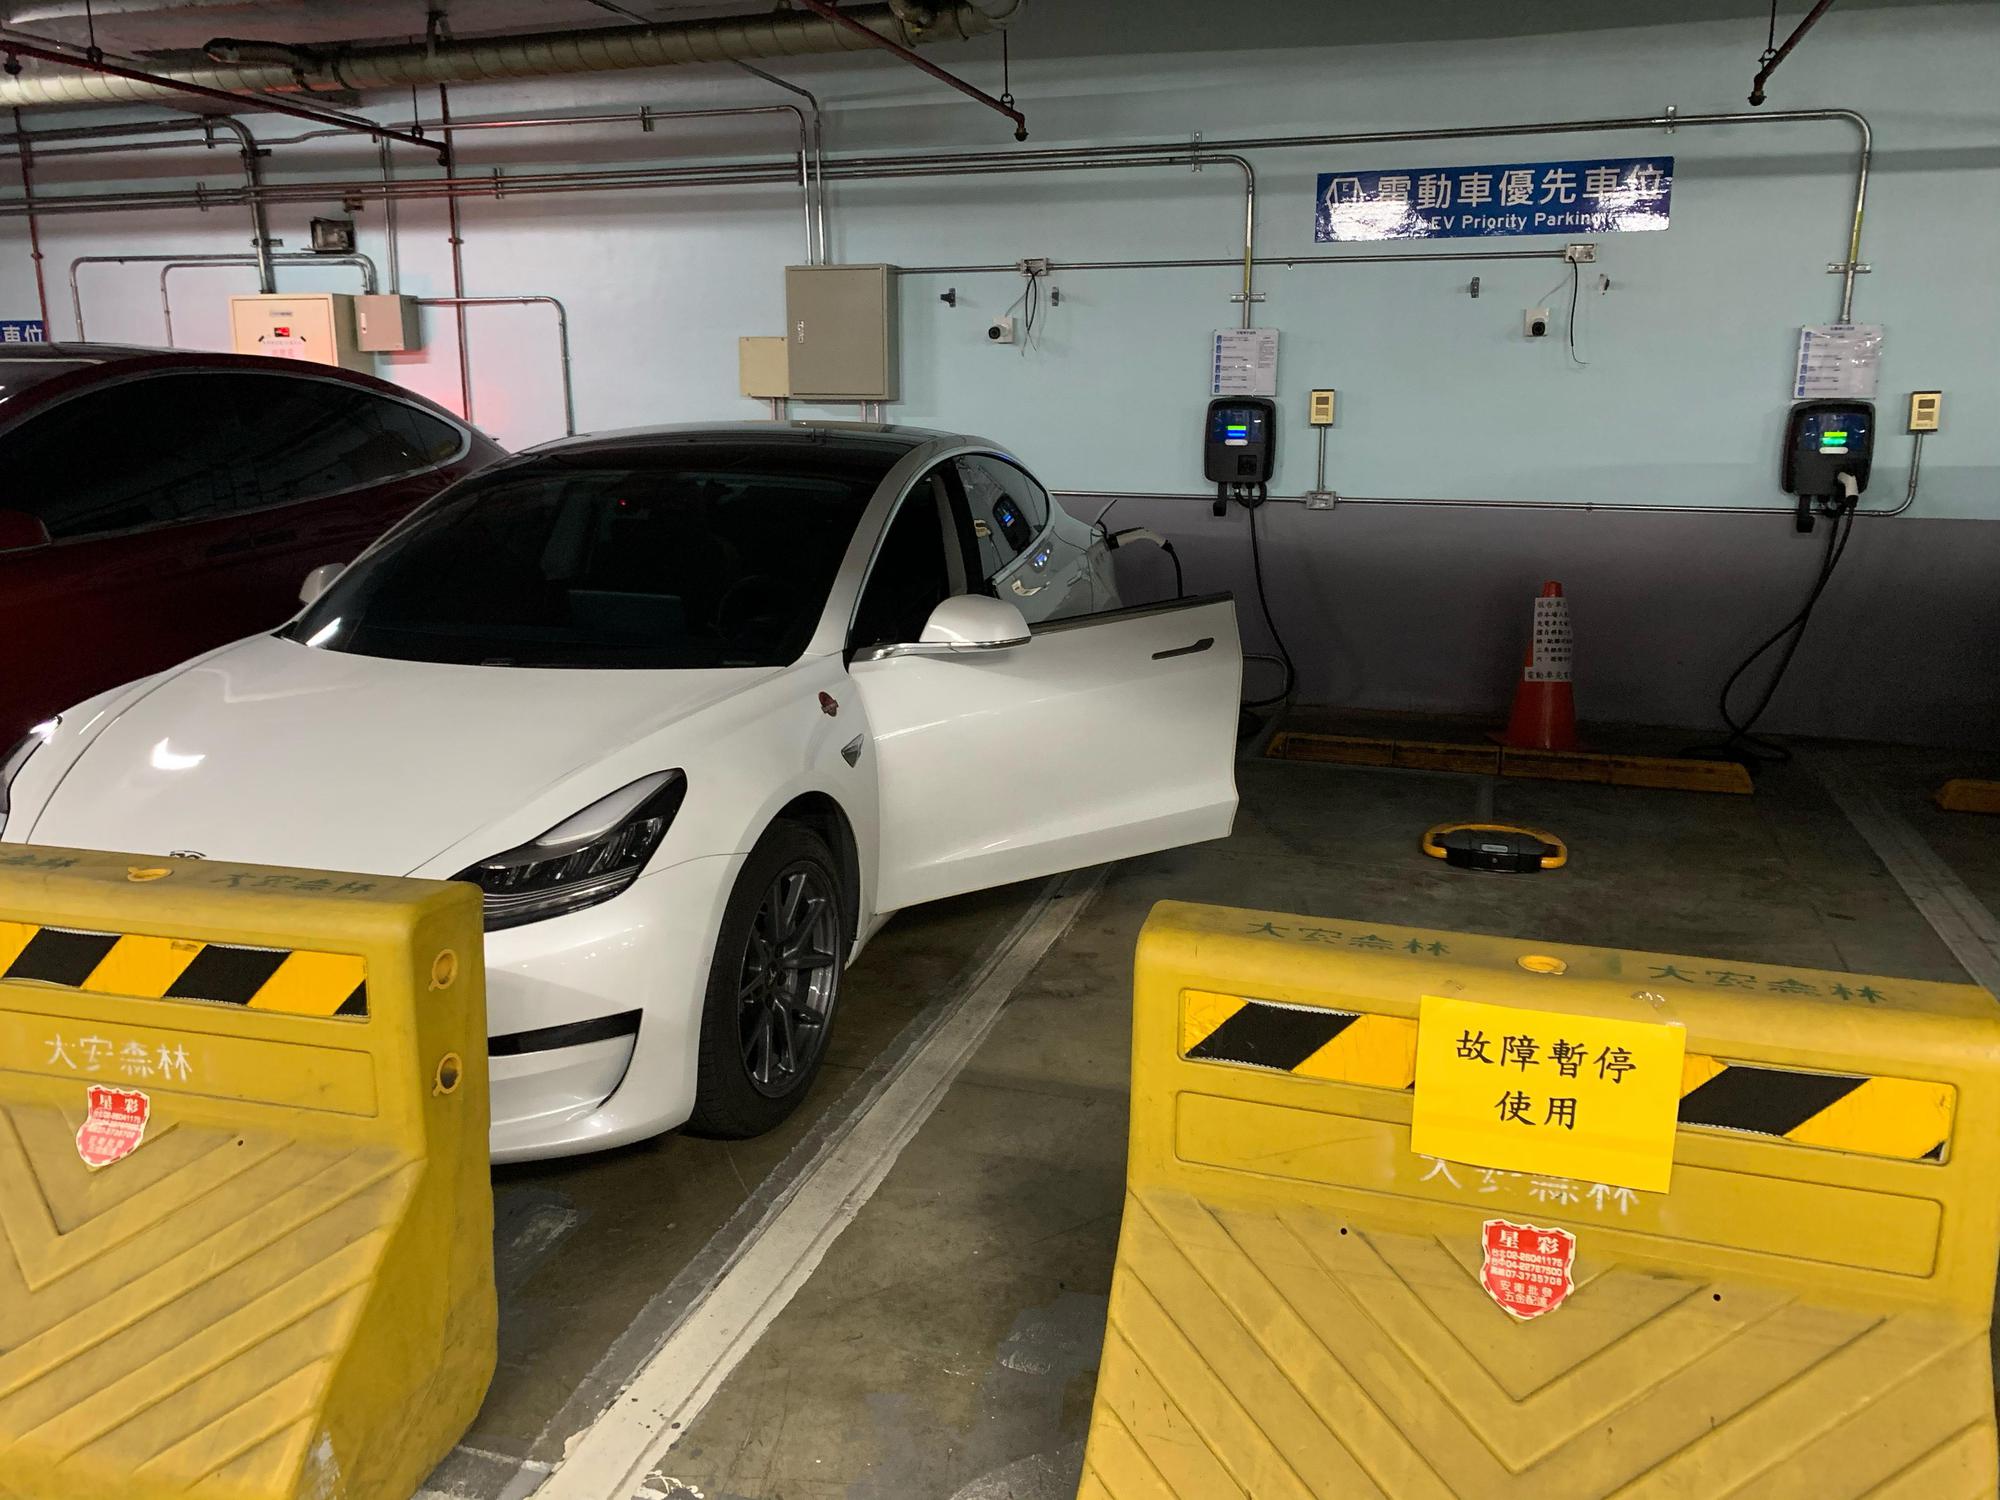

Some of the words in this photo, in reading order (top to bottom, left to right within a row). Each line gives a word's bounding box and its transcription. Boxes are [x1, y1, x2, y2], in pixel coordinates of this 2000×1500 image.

[1378, 164, 1664, 210] 電動車優先車位
[1431, 216, 1455, 231] EV
[1462, 213, 1527, 231] Priority
[1247, 922, 1450, 956] 大安森林
[1647, 966, 1888, 1003] 大安森林
[44, 1034, 193, 1082] 大安森林
[1456, 1029, 1637, 1084] 故障暫停
[1494, 1090, 1577, 1130] 使用
[1499, 1229, 1559, 1254] 星彩
